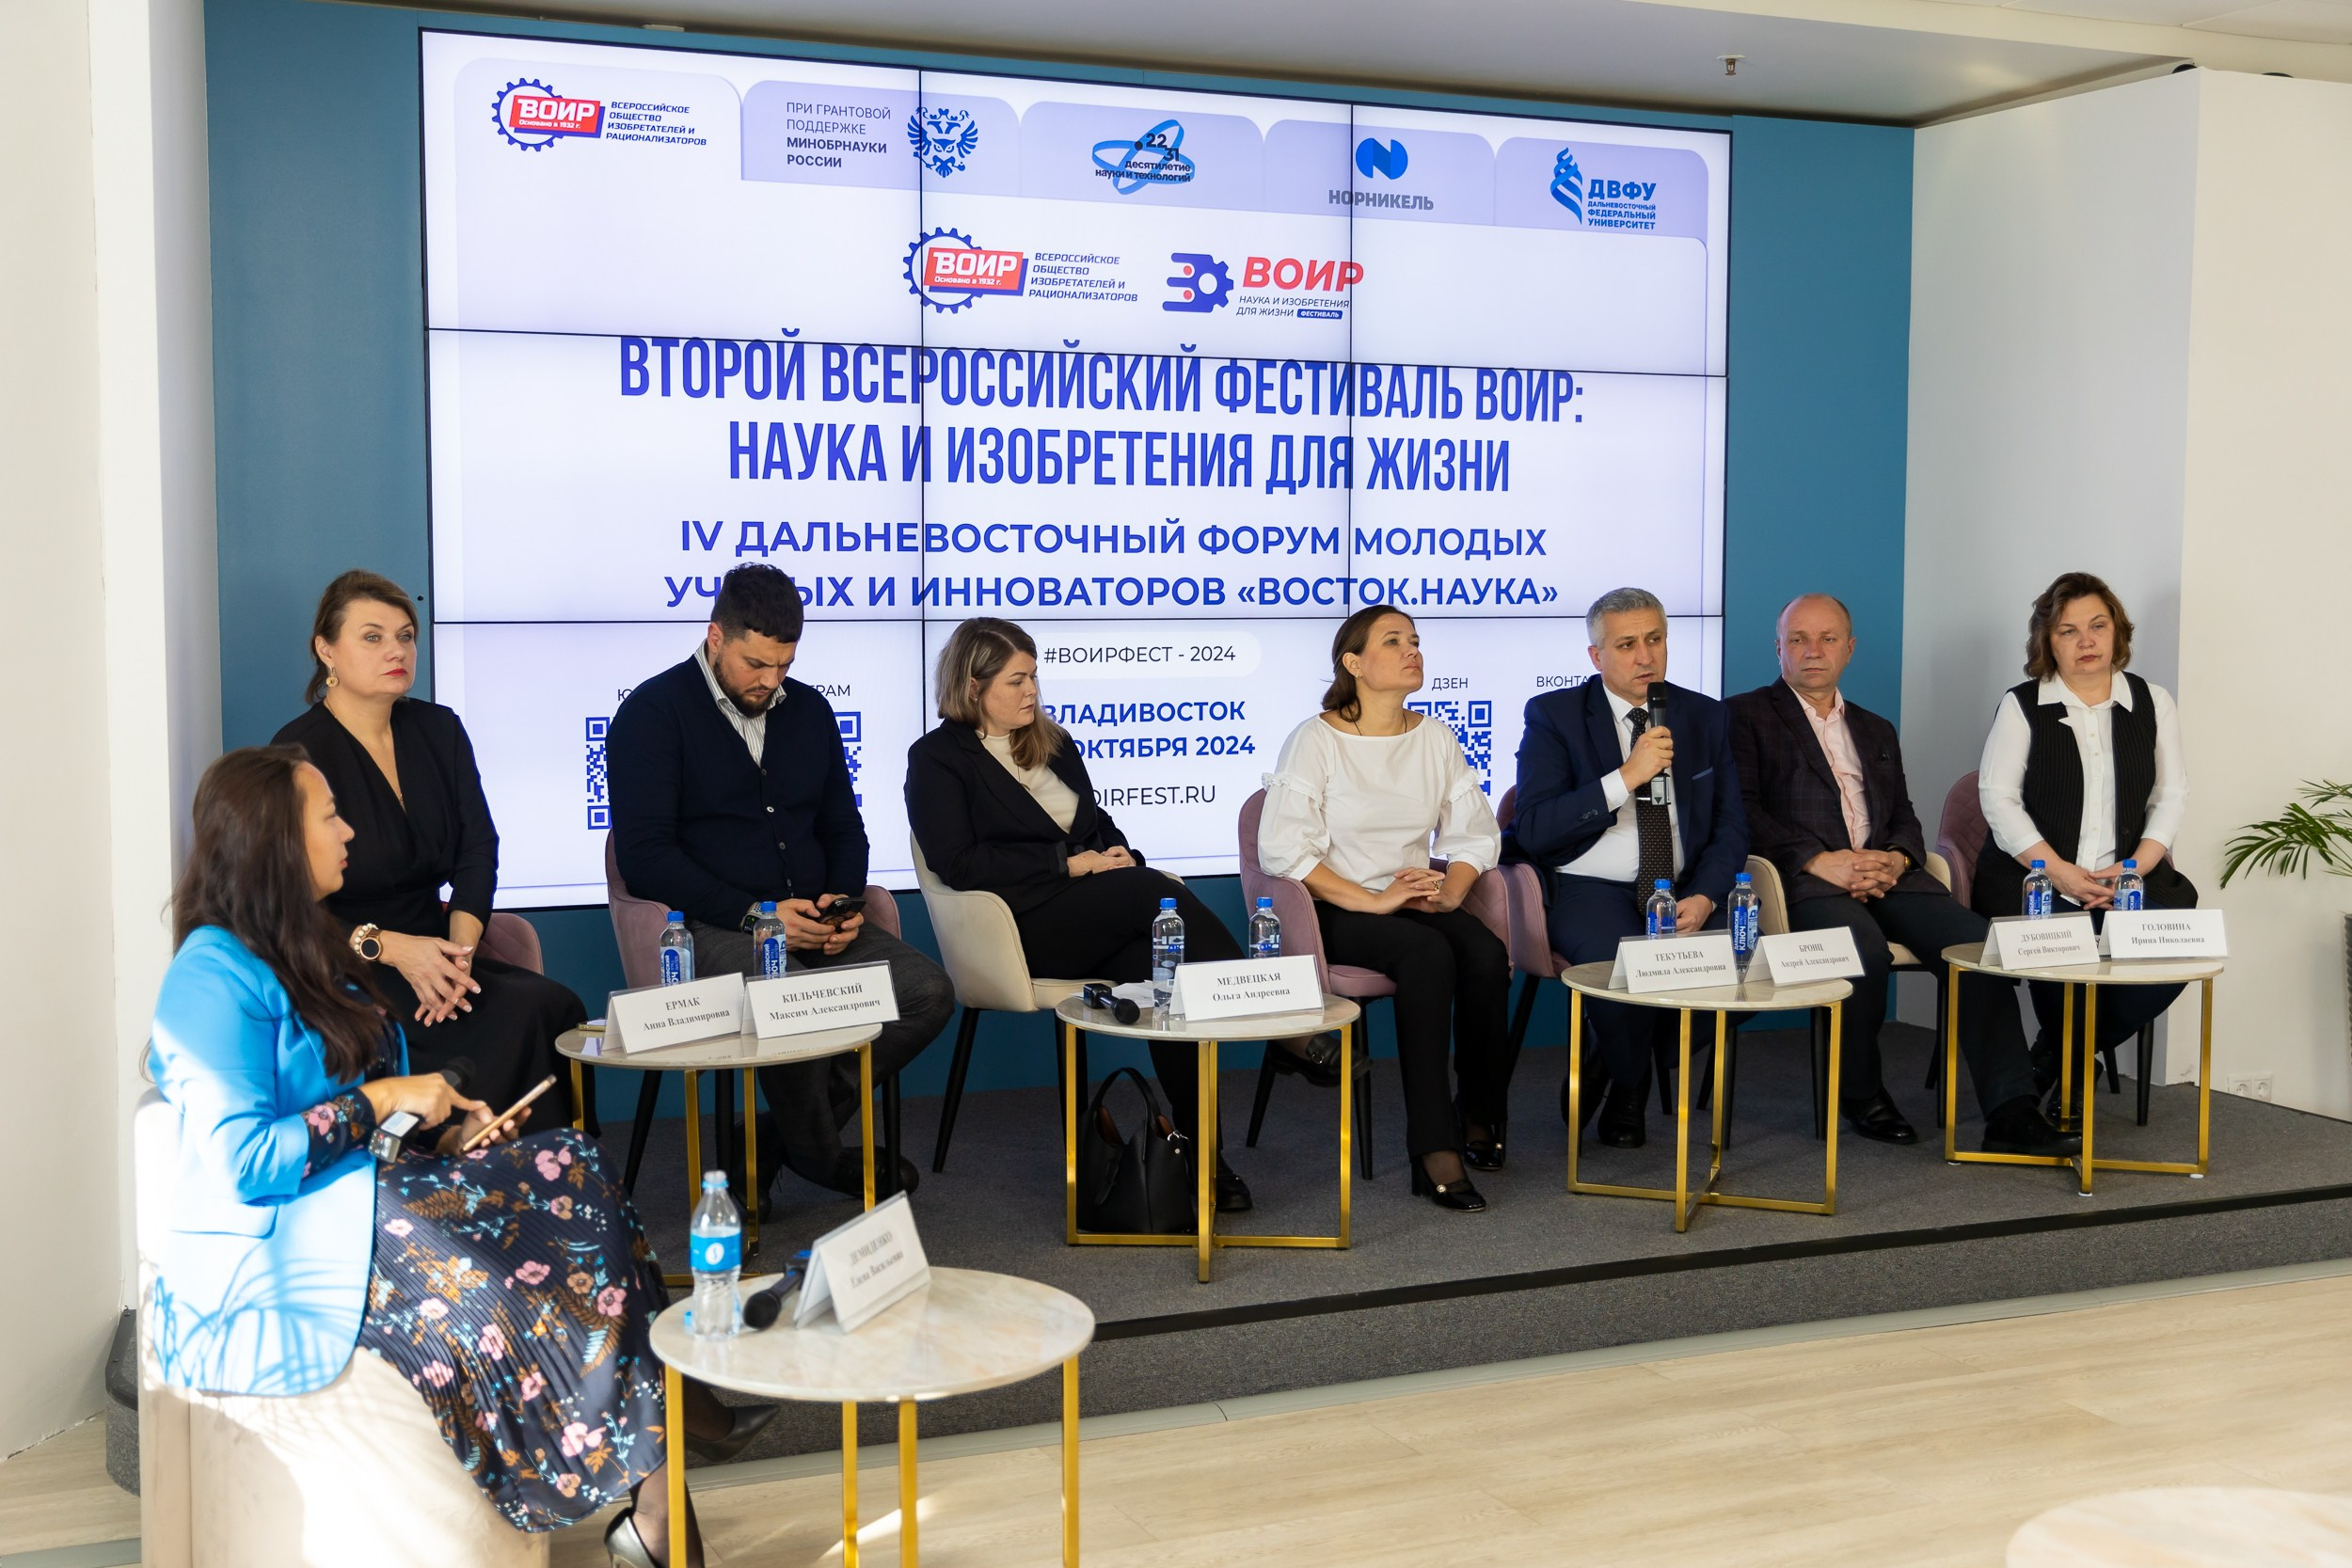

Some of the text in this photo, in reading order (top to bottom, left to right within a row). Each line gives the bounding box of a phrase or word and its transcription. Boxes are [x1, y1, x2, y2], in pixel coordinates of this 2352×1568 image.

[517, 99, 596, 122] ВОИР
[611, 101, 691, 114] ВСЕРОССИЙСКОЕ
[787, 102, 891, 119] ПРИ ГРАНТОВОЙ
[518, 119, 553, 128] Основано
[560, 120, 575, 129] 1932
[609, 112, 662, 122] ОБЩЕСТВО
[607, 121, 686, 135] ИЗОБРЕТАТЕЛЕЙ
[787, 119, 866, 135] ПОДДЕРЖКЕ
[606, 132, 707, 146] РАЦИОНАЛИЗАТОРОВ
[787, 136, 887, 153] МИНОБРНАУКИ
[1146, 133, 1168, 149] 22
[787, 154, 842, 167] РОССИИ
[1163, 148, 1180, 162] 31
[1095, 169, 1124, 179] науки
[1134, 171, 1191, 182] технологий
[1587, 179, 1657, 201] ДВФУ
[1328, 190, 1435, 211] НОРНИКЕЛЬ
[1587, 200, 1656, 212] ДАЛЬНЕВОСТОЧНЫЙ
[1587, 208, 1656, 220] ФЕДЕРАЛЬНЫЙ
[1587, 218, 1656, 230] УНИВЕРСИТЕТ
[932, 251, 1018, 277] ВОИР
[1035, 252, 1120, 265] ВСЕРОССИЙСКОЕ
[1032, 264, 1089, 276] ОБЩЕСТВО
[1243, 256, 1364, 292] ВОИР
[934, 276, 970, 285] Основано
[978, 277, 995, 286] 1932
[1030, 277, 1116, 289] ИЗОБРЕТАТЕЛЕЙ
[1028, 289, 1138, 302] РАЦИОНАЛИЗАТОРОВ
[1239, 295, 1349, 309] НАУКА И ИЗОБРЕТЕНИЯ
[1236, 307, 1295, 317] ДЛЯ ЖИЗНИ
[620, 327, 1583, 423] ВТОРОЙ ВСЕРОССИЙСКИЙ ФЕСТИВАЛЬ ВОИР:
[729, 420, 1510, 495] НАУКА И ИЗОБРЕТЕНИЯ ДЛЯ ЖИЗНИ
[681, 517, 1548, 562] IV ДАЛЬНЕВОСТОЧНЫЙ ФОРУМ МОЛОДЫХ
[664, 577, 1559, 608] УЧЫХ И ИННОВАТОРОВ «ВОСТОК.НАУКА»
[1043, 646, 1173, 664] #ВОИРФЕСТ
[1190, 645, 1236, 662] 2024
[1431, 677, 1469, 691] ДЗЕН
[1041, 701, 1246, 727] ВЛАДИВОСТОК
[1196, 736, 1255, 756] 2024
[1093, 784, 1216, 806] IRFEST.RU
[2141, 923, 2191, 931] ГОЛОВИНА
[2021, 929, 2073, 942] ДУБОВИЦКИЙ
[2131, 936, 2205, 946] Ирина Николаевна
[1798, 942, 1824, 953] БРОНЦ
[2017, 944, 2081, 957] Сергей Викторович
[1655, 950, 1704, 962] ТЕКУТЬЕВА
[1635, 964, 1726, 978] Людмила Александровна
[1216, 972, 1281, 987] МЕДВЕЦКАЯ
[782, 982, 863, 1004] КИЛЬЧЕВСКИЙ
[1213, 988, 1291, 1002] Ольга Андреевна
[665, 997, 700, 1011] ЕРМАК
[769, 999, 881, 1022] Максим Александрович
[644, 1009, 730, 1031] Анна Владимировна
